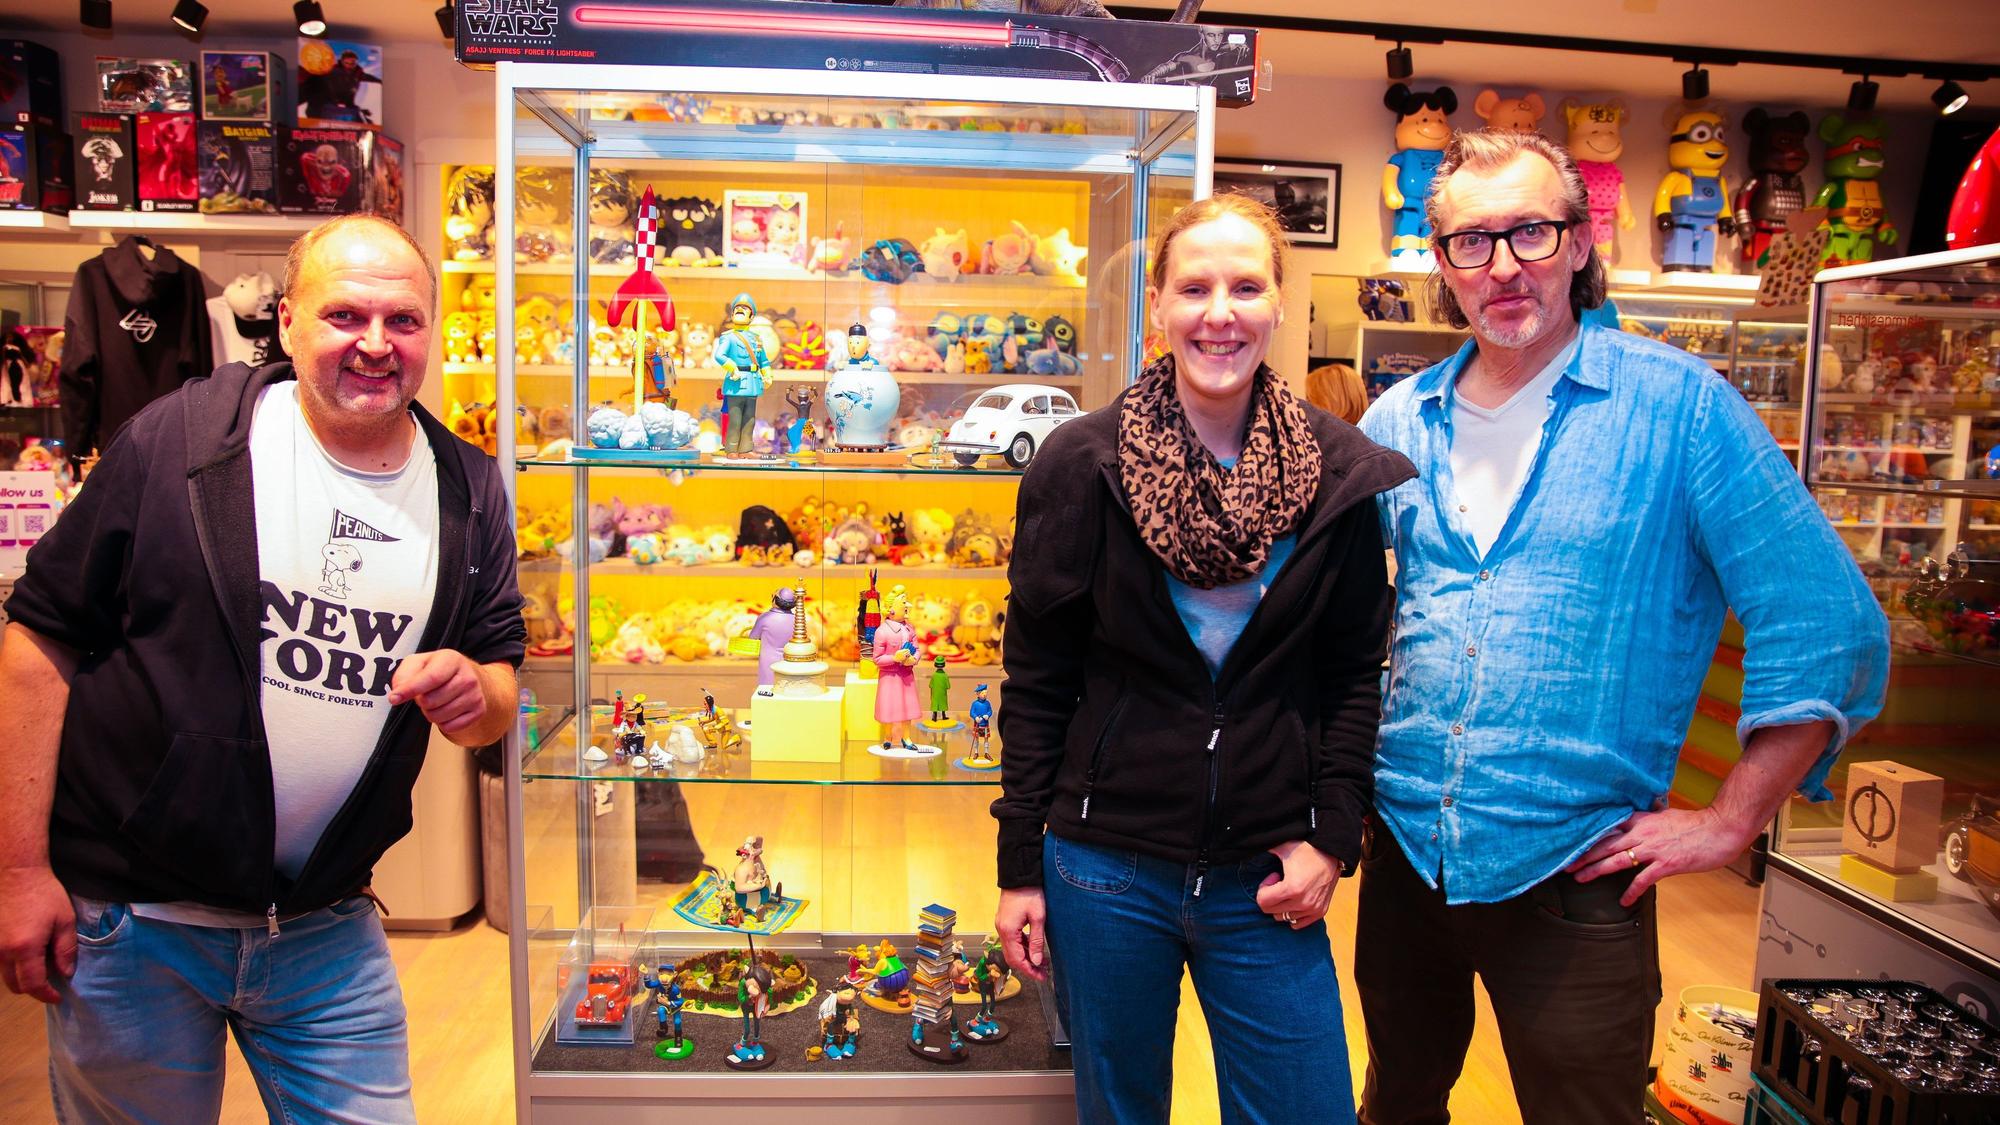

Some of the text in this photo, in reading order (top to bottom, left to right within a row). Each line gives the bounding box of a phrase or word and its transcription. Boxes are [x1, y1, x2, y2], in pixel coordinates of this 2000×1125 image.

[465, 13, 559, 37] WARS
[222, 125, 272, 138] BATGIRL
[0, 488, 44, 497] llow us
[335, 512, 383, 541] PEANUTS
[260, 580, 413, 652] NEW
[260, 627, 405, 697] ORK
[262, 676, 374, 708] COOL SINCE FOREVER
